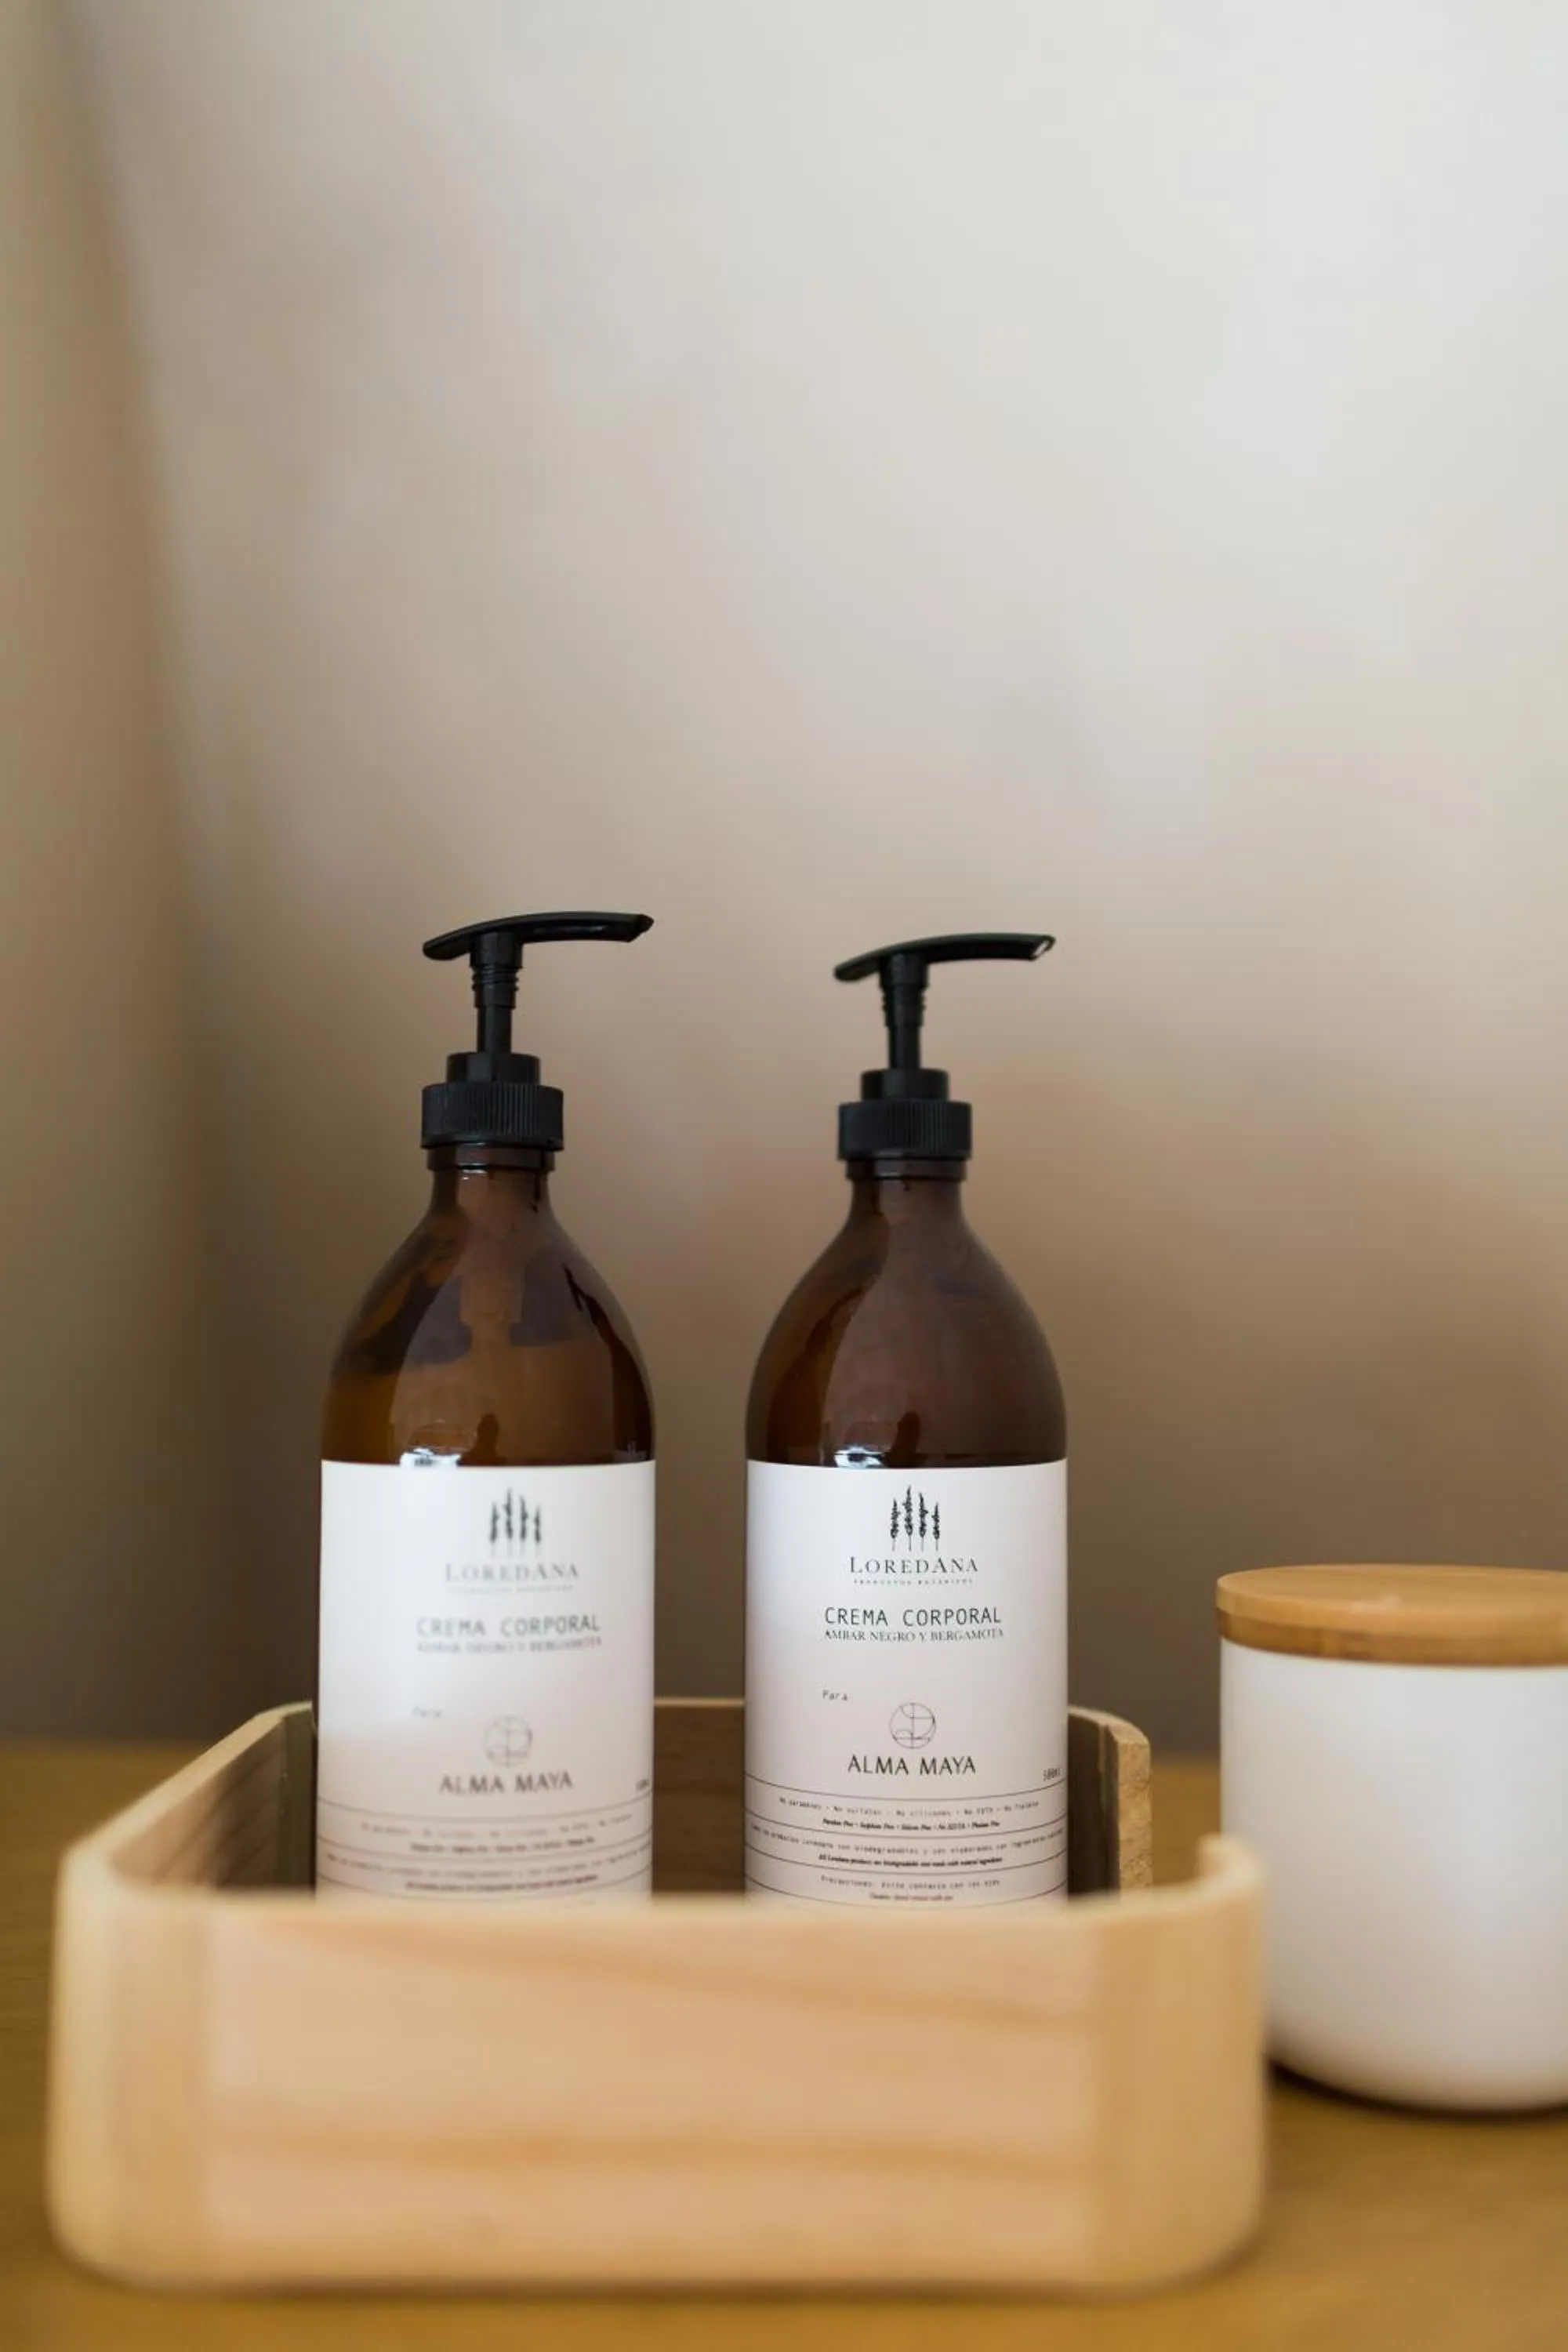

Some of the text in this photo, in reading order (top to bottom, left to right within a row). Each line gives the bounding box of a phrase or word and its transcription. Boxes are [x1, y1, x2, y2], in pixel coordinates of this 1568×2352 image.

[850, 1556, 978, 1573] LOREDANA
[416, 1613, 601, 1639] CREMA CORPORAL
[825, 1606, 1001, 1627] CREMA CORPORAL
[869, 1631, 916, 1642] NEGRO
[918, 1632, 927, 1642] Y
[930, 1628, 1004, 1641] BERGAMOTA
[822, 1690, 849, 1702] Para
[848, 1754, 977, 1776] ALMA MAYA
[439, 1770, 574, 1795] ALMA MAYA
